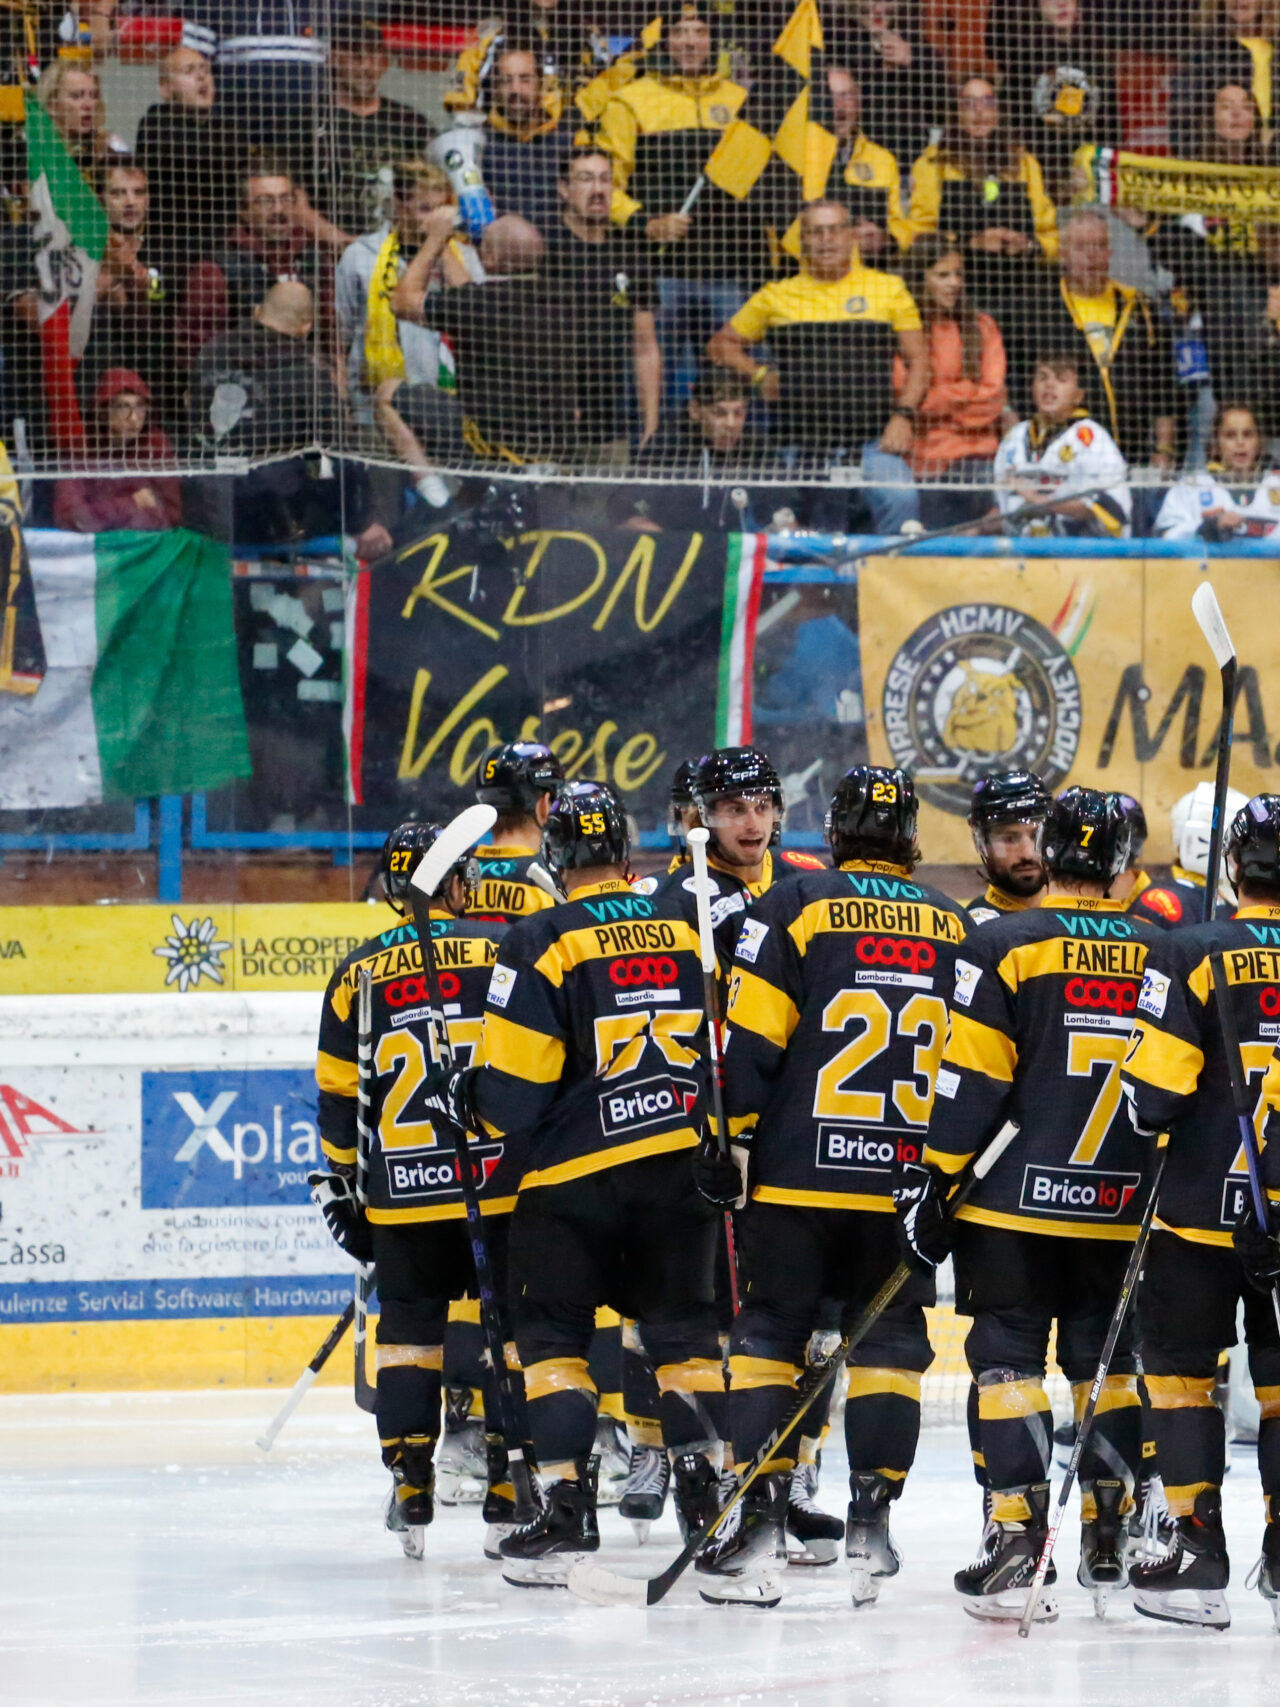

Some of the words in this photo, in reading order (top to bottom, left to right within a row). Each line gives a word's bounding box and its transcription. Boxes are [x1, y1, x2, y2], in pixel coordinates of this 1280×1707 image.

[397, 530, 703, 641] KDN
[938, 605, 1024, 638] HCMV
[885, 652, 920, 771] VARESE
[1042, 654, 1082, 771] HOCKEY
[485, 759, 497, 779] 5
[872, 782, 897, 804] 23
[1006, 798, 1036, 809] CCM
[579, 812, 606, 835] 55
[1079, 825, 1094, 848] 7
[389, 851, 412, 872] 27
[598, 880, 620, 893] yop!
[847, 873, 923, 900] VIVO
[582, 897, 653, 922] VIVO
[828, 900, 921, 933] BORGHI
[932, 910, 957, 940] M.
[1076, 898, 1099, 910] yop!
[594, 922, 676, 954] PIROSO
[1055, 914, 1132, 938] VIVO
[855, 935, 937, 973] coop
[608, 955, 679, 989] coop
[856, 973, 903, 984] Lombardia
[1064, 977, 1137, 1016] coop
[1065, 1016, 1111, 1027] Lombardia
[812, 988, 951, 1127] 23
[1125, 1028, 1145, 1063] 7
[1066, 1032, 1129, 1165] 7
[173, 1091, 319, 1180] Xpla
[0, 1293, 68, 1313] ulenze
[78, 1290, 145, 1311] Servizi
[155, 1287, 245, 1309] Software
[254, 1285, 352, 1307] Hardware
[1090, 1361, 1108, 1402] BAUER
[1006, 1554, 1036, 1590] CCM
